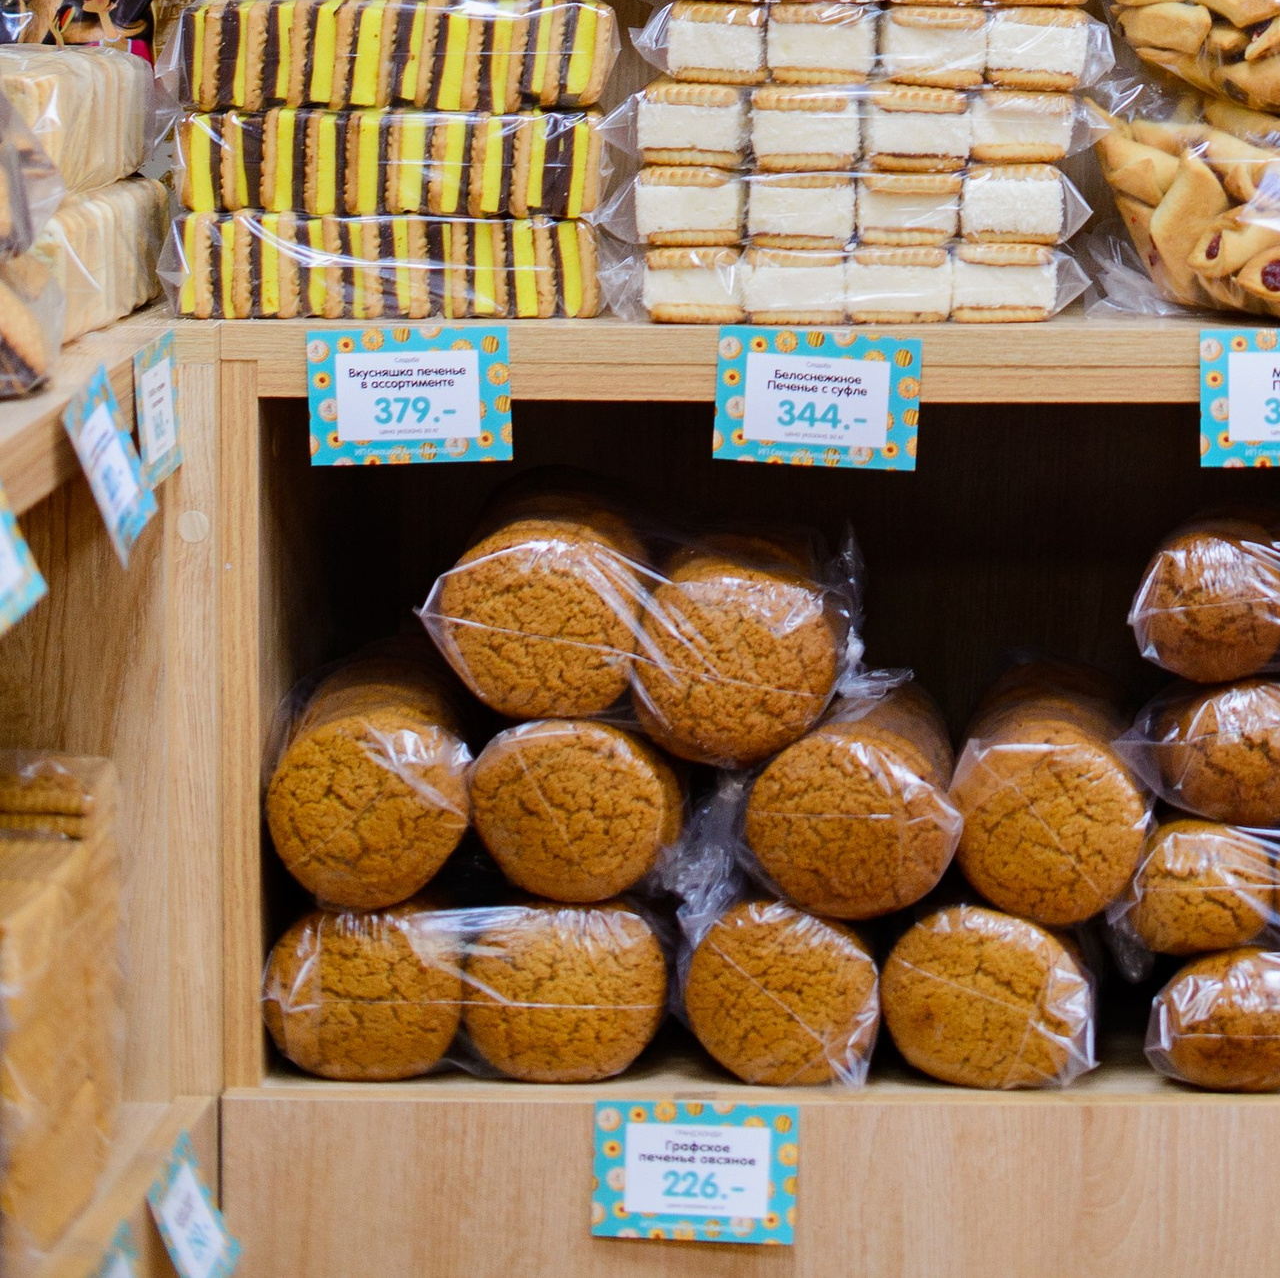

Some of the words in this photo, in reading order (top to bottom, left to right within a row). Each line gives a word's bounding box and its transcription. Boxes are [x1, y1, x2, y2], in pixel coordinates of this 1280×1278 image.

[348, 368, 413, 380] Вкусняшка
[417, 366, 466, 377] печенье
[372, 379, 455, 391] ассортименте
[767, 380, 818, 393] Печенье
[831, 386, 868, 398] суфле
[374, 396, 457, 425] 379.-
[777, 399, 868, 431] 344.-
[665, 1140, 730, 1154] Графское
[638, 1154, 696, 1164] печенье
[700, 1155, 756, 1166] овсяное
[662, 1170, 745, 1200] 226.-
